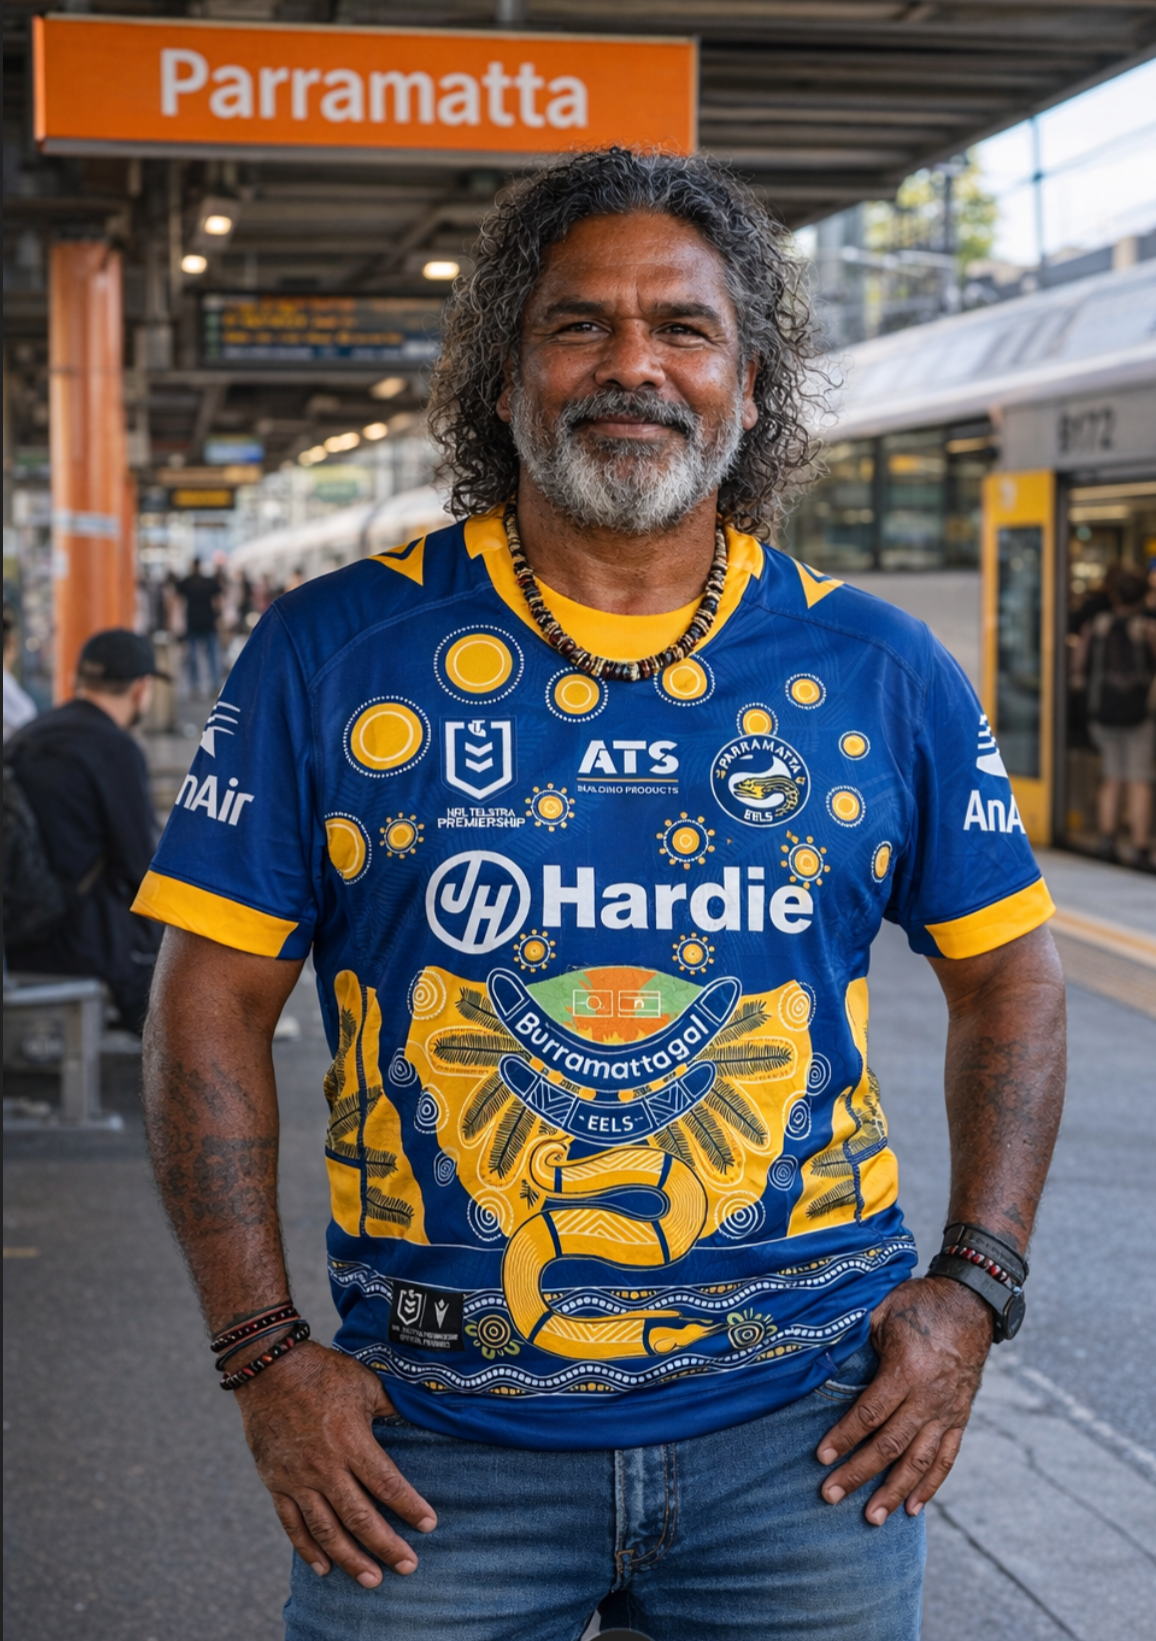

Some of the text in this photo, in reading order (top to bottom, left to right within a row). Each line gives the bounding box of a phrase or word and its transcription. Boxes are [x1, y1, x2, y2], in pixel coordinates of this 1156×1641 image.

[160, 48, 588, 129] Parramatta
[577, 740, 680, 775] ATS
[718, 738, 801, 774] PARRAMATTA
[437, 817, 526, 829] PREMIERSHIP
[469, 807, 516, 817] TELSTRA
[542, 865, 814, 934] Hardie
[514, 1011, 710, 1080] Burramattagal
